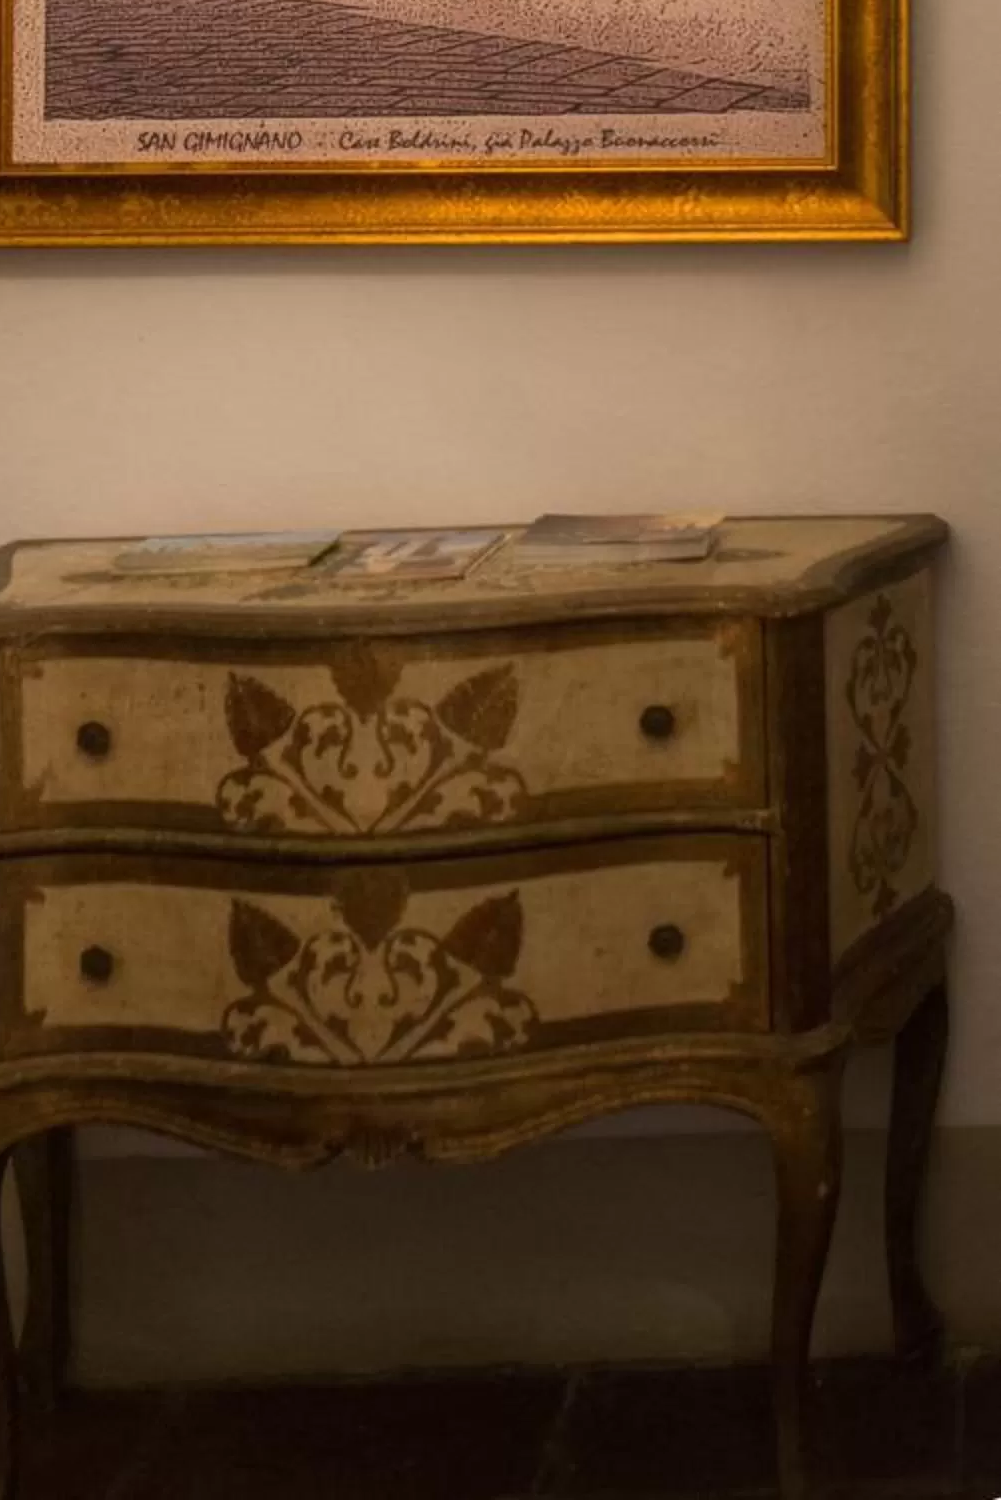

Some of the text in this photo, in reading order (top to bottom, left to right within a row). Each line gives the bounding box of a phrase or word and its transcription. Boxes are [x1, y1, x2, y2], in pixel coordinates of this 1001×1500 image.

[137, 131, 176, 151] SAN
[184, 131, 302, 152] GIMIGNANO
[520, 128, 593, 156] Palazzo
